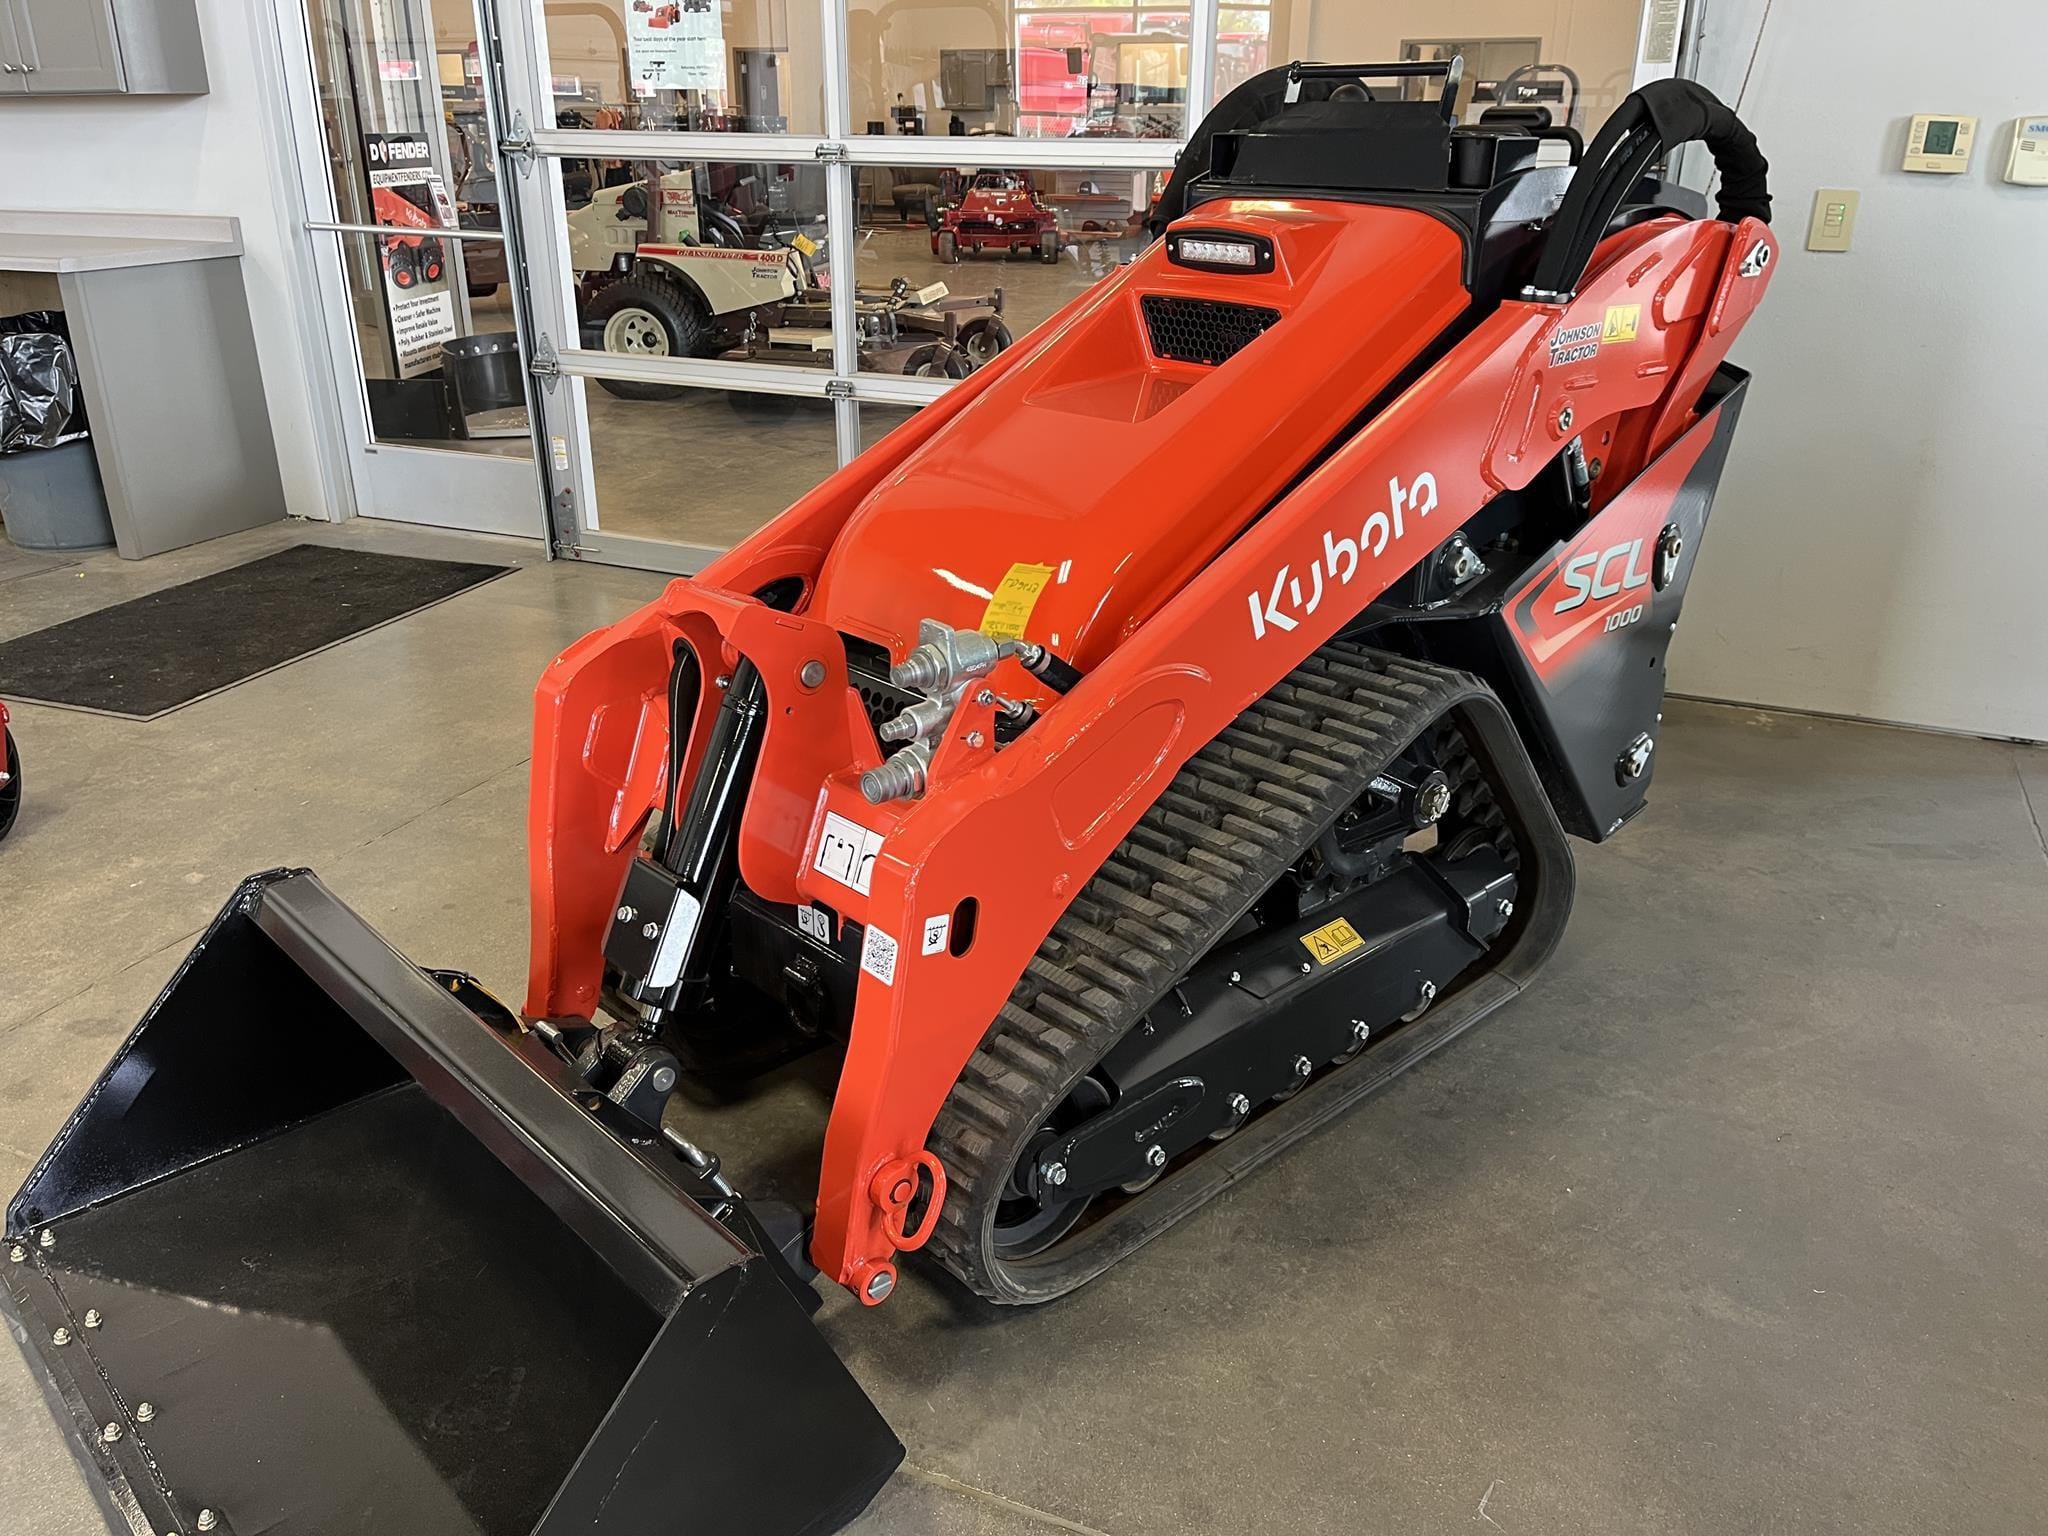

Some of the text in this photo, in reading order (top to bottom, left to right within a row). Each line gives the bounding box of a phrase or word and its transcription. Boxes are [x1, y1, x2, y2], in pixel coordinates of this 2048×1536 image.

[2028, 124, 2048, 133] SM
[676, 249, 744, 260] GRASSHOPPER
[1551, 323, 1601, 347] JOHNSON
[1550, 343, 1598, 367] TRACTOR
[1248, 471, 1438, 641] Kubota
[1553, 538, 1648, 615] SCL
[1603, 604, 1643, 633] 1000
